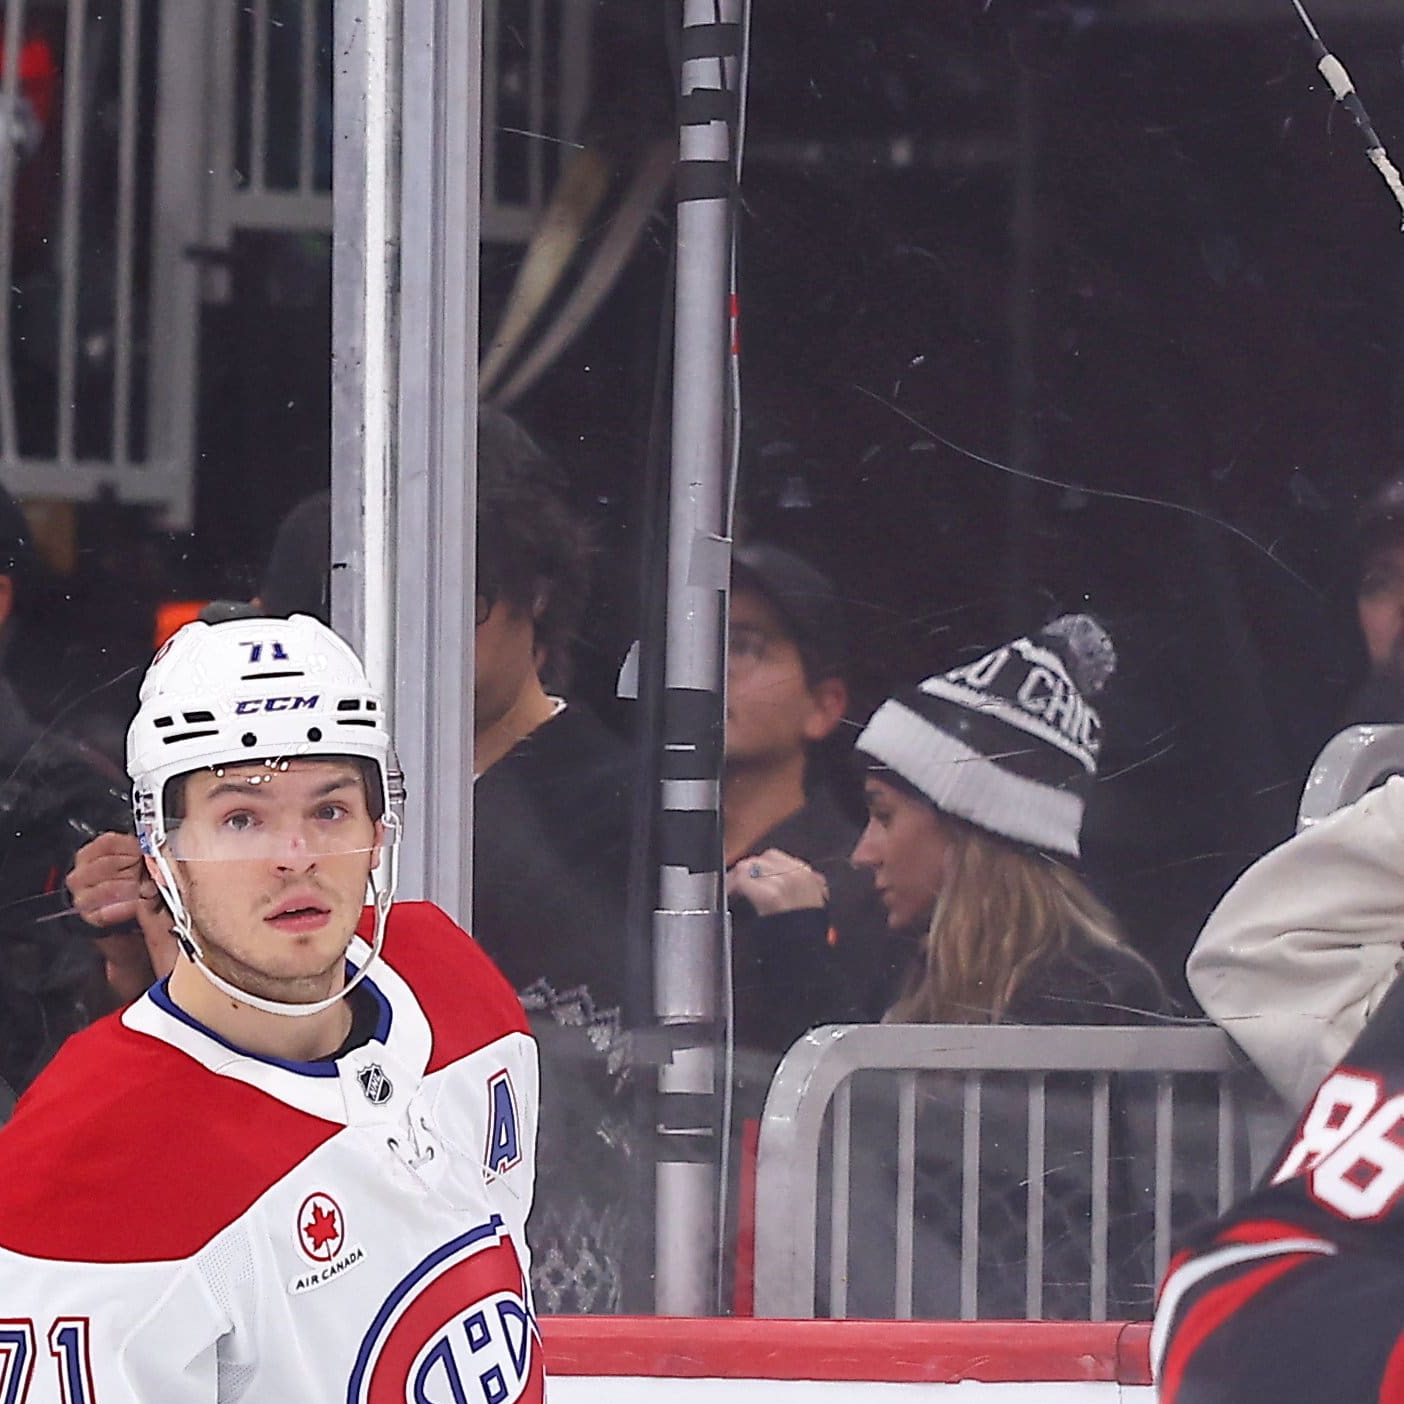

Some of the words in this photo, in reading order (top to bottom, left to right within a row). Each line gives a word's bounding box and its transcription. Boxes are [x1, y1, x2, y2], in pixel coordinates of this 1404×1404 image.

[239, 640, 289, 664] 71
[234, 694, 321, 716] CCM
[482, 1067, 523, 1186] A
[295, 1274, 319, 1291] AIR
[321, 1247, 364, 1281] CANADA
